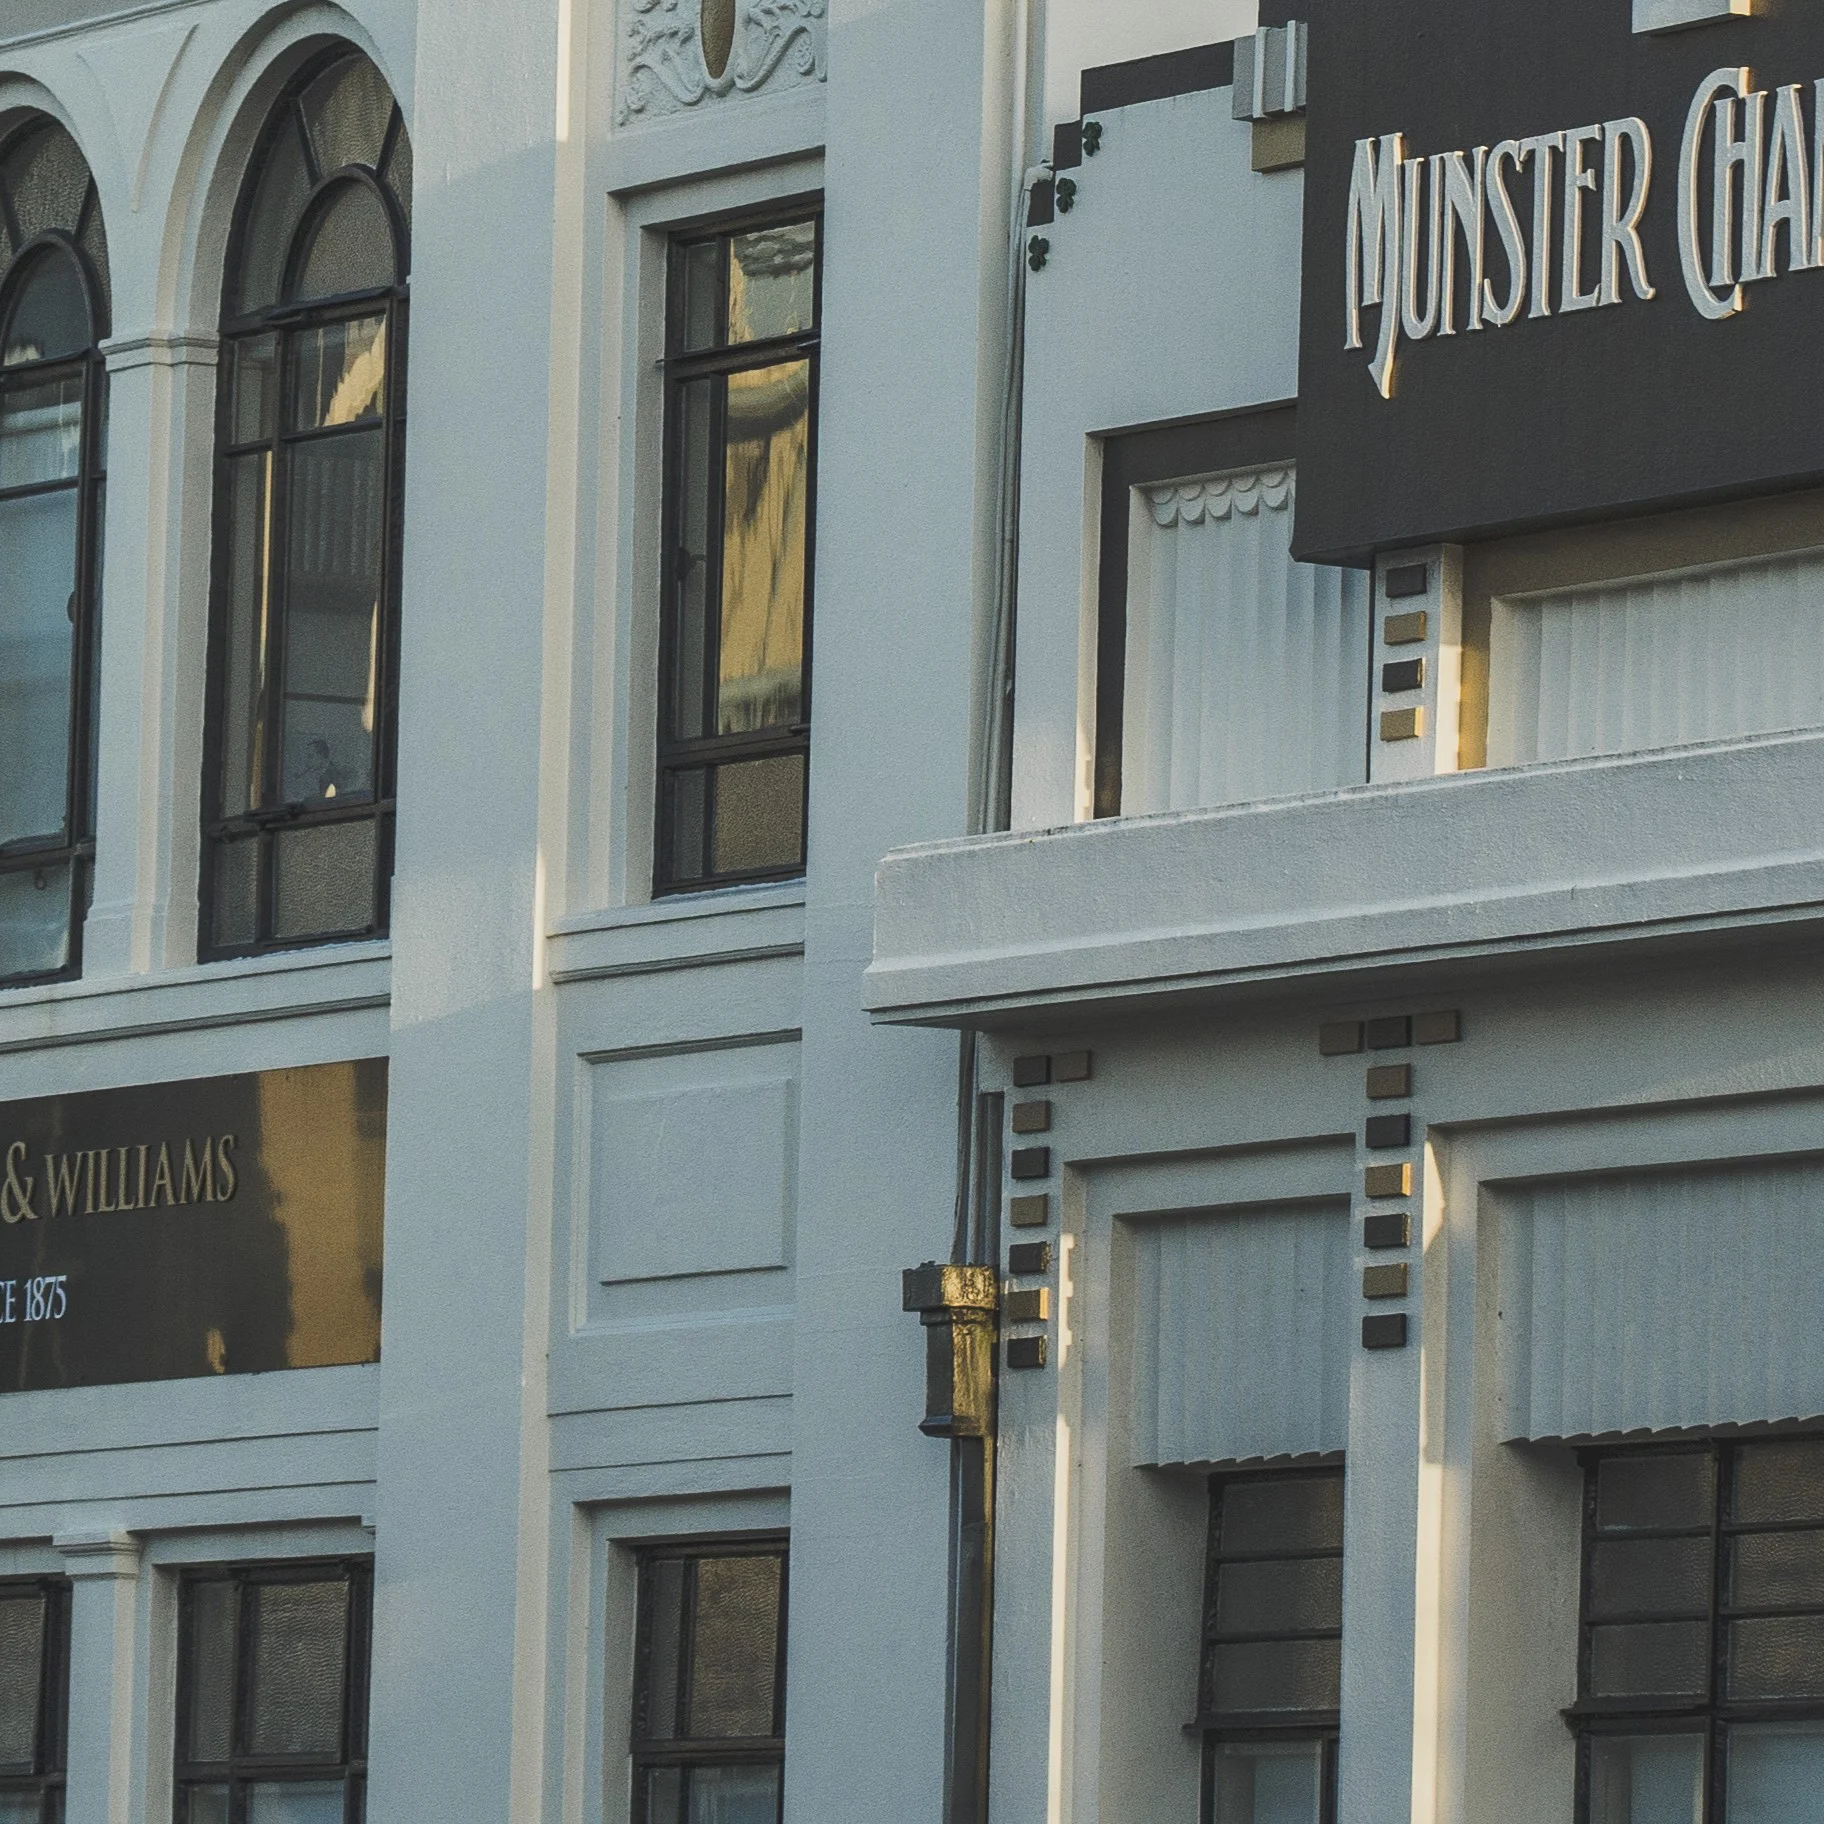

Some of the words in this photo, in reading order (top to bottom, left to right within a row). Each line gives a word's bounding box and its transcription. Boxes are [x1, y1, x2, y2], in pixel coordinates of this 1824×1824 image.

[1343, 116, 1657, 400] MUNSTER
[1677, 66, 1824, 319] CHA
[0, 1140, 40, 1224] &
[43, 1134, 238, 1219] WILLIAMS
[23, 1274, 68, 1322] 1875
